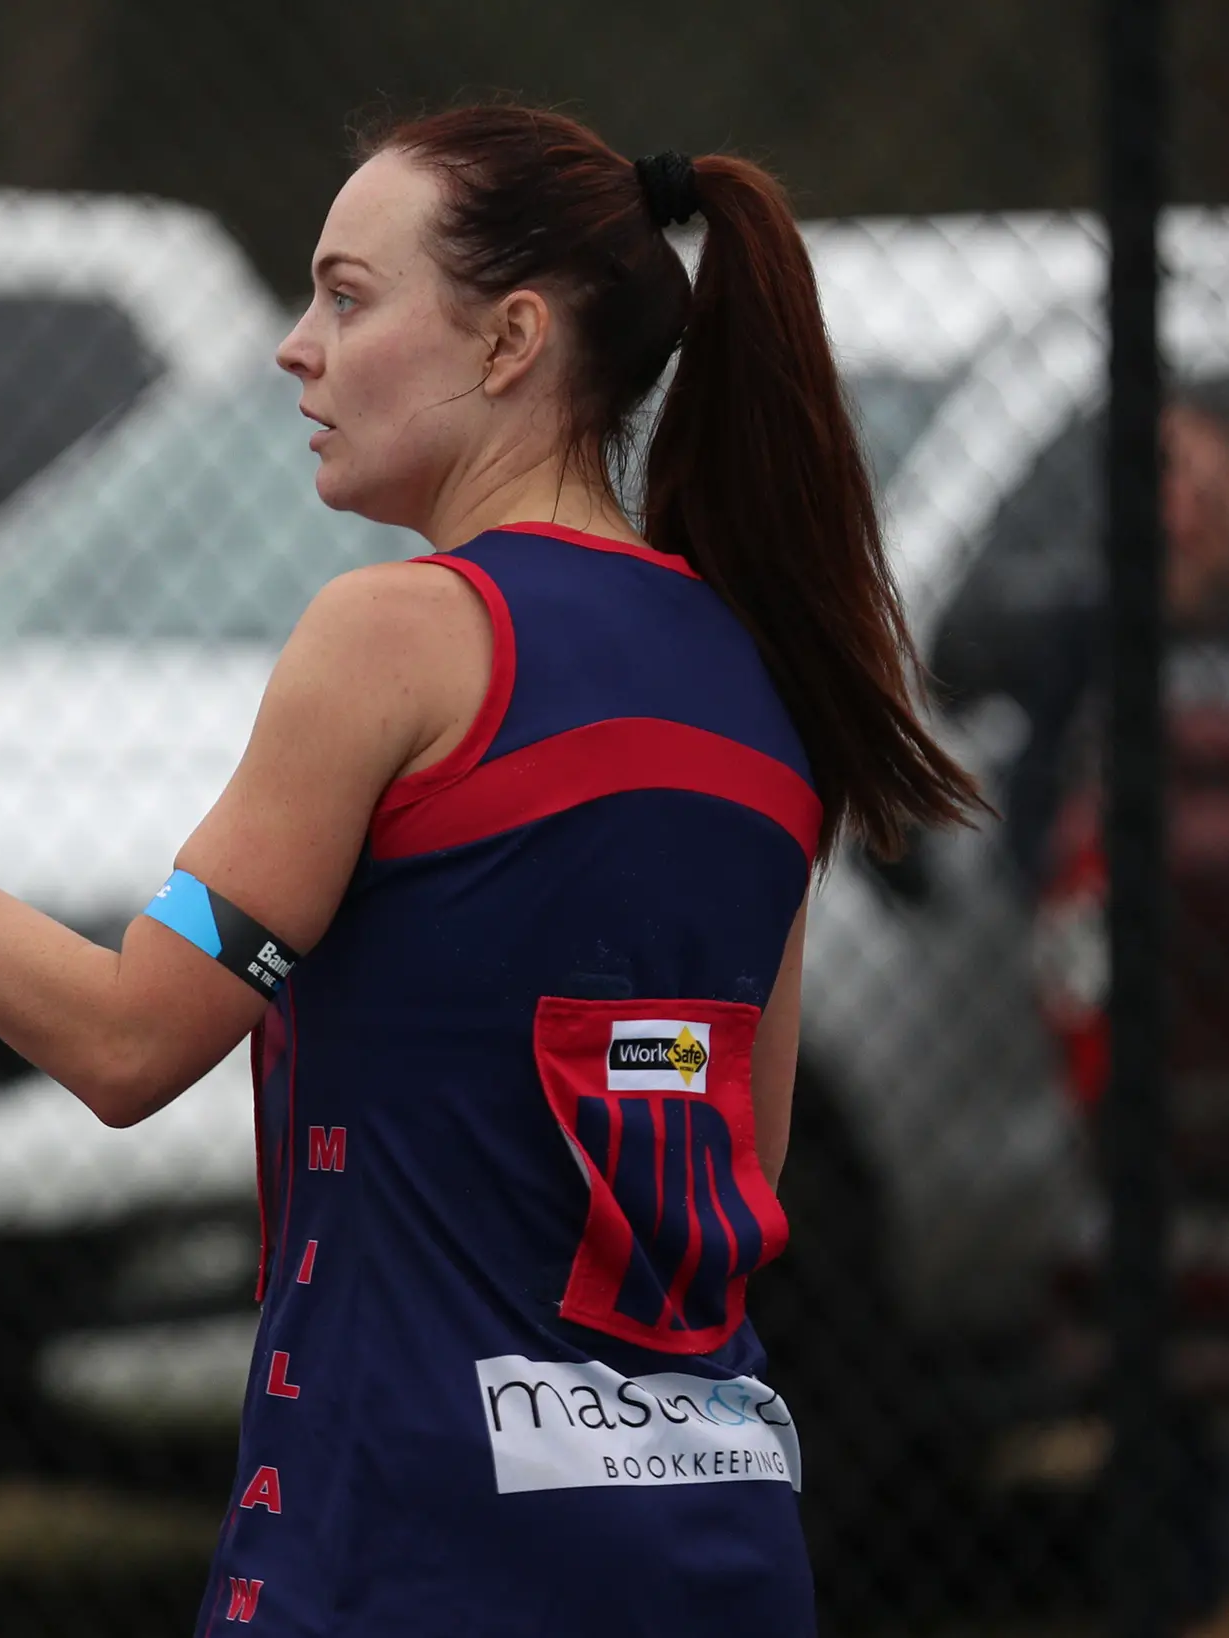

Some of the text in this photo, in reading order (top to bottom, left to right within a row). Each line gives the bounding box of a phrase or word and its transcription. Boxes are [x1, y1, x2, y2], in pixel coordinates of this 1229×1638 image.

[247, 961, 277, 988] BE THE
[619, 1042, 702, 1065] WorkSafe
[603, 1450, 784, 1479] BOOKKEEPING
